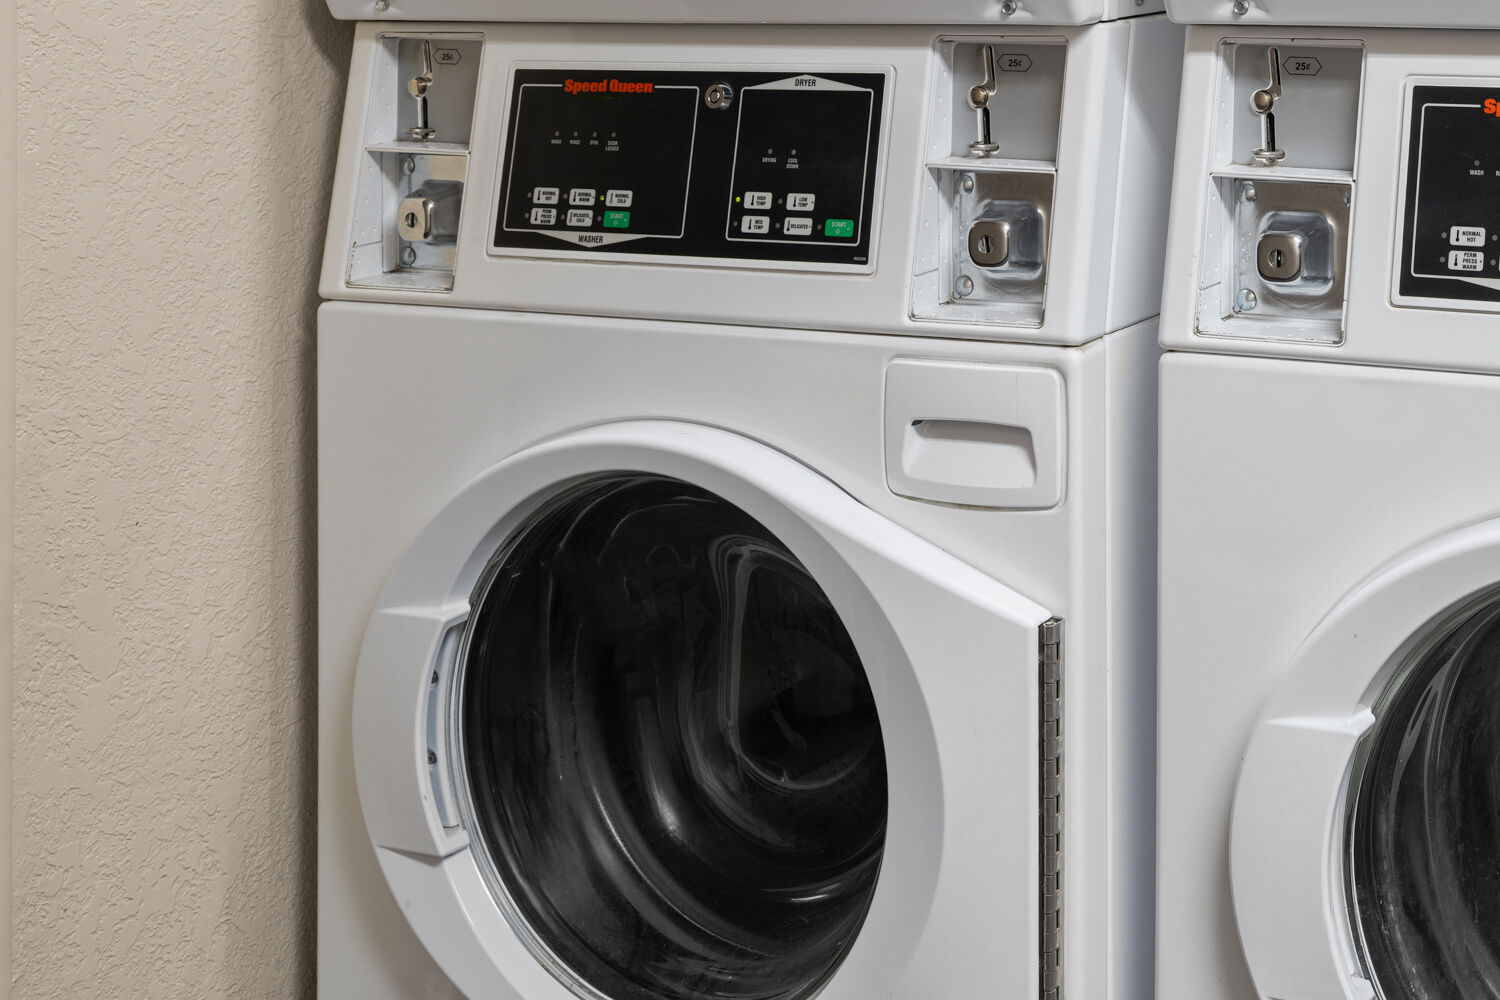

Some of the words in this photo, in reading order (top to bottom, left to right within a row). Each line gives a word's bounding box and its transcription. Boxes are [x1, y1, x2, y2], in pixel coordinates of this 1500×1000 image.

[1295, 62, 1311, 71] 25¢
[564, 78, 608, 95] Speed
[609, 78, 654, 93] Queen
[795, 79, 817, 87] DRYER
[578, 235, 604, 244] WASHER
